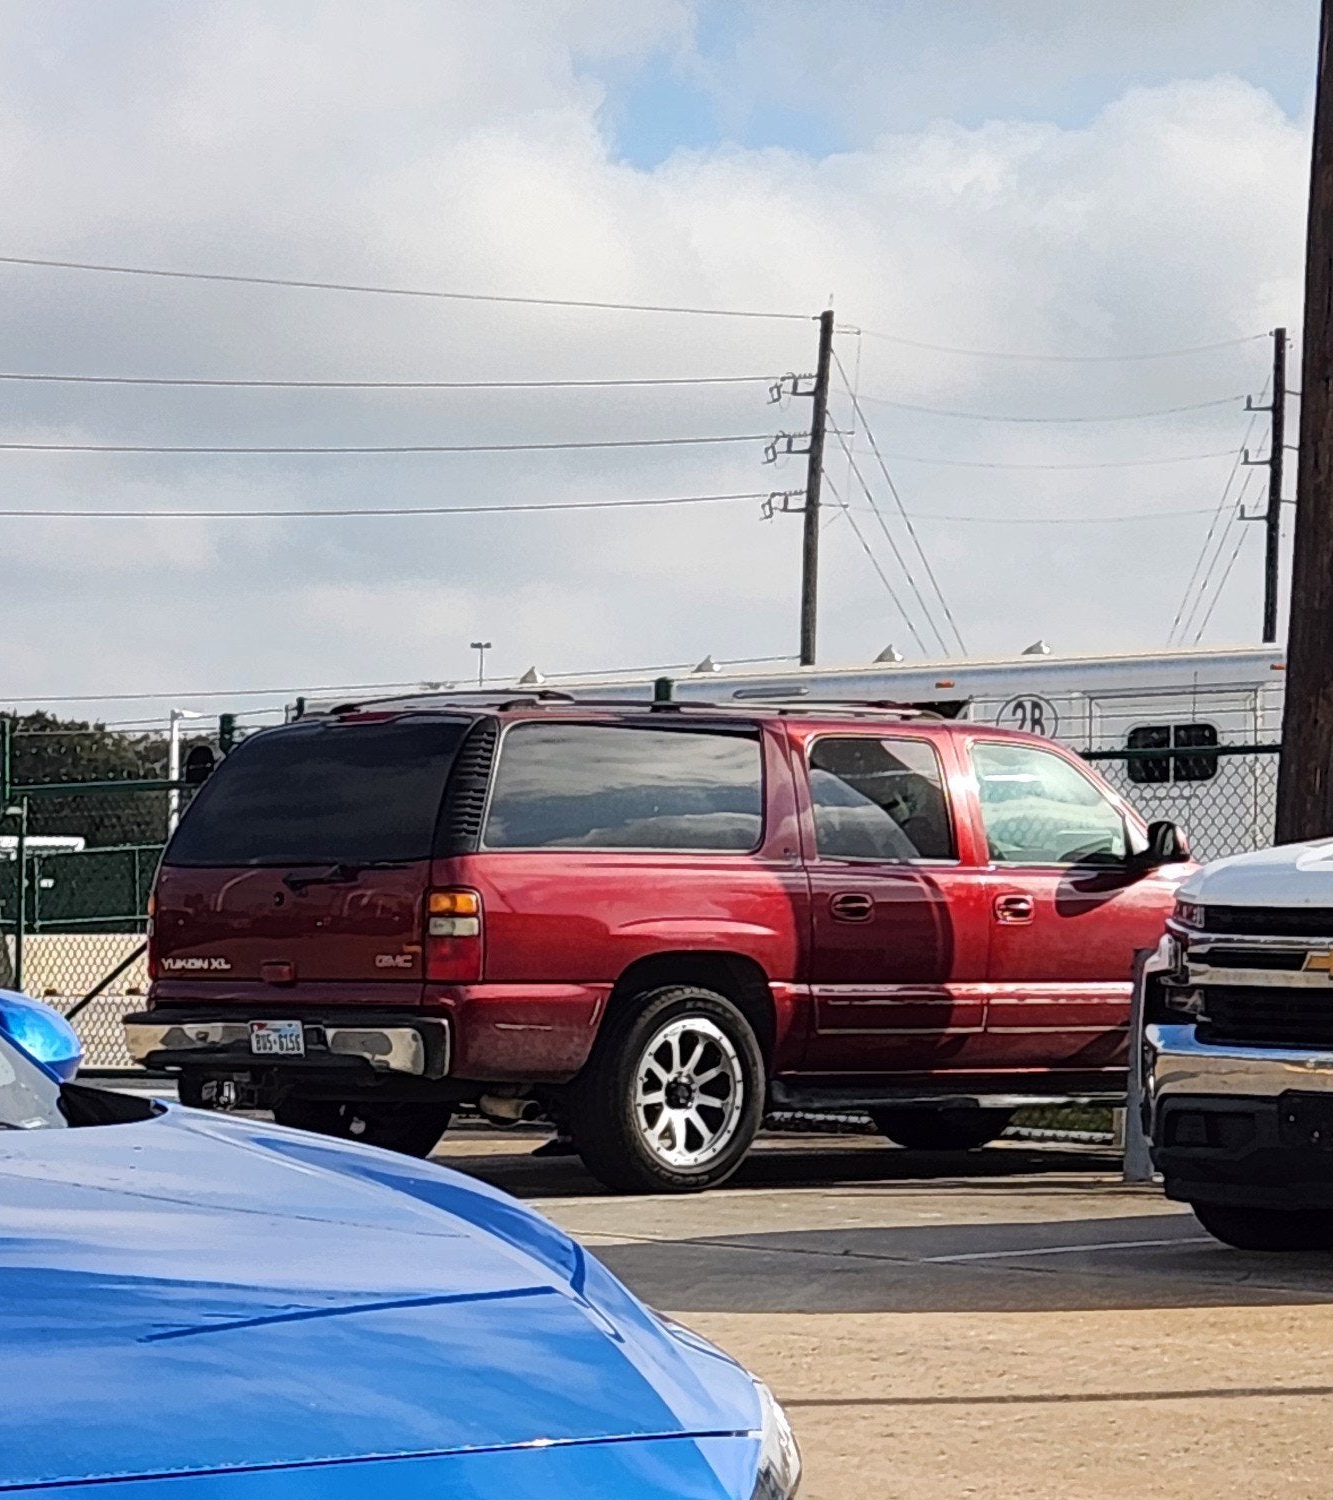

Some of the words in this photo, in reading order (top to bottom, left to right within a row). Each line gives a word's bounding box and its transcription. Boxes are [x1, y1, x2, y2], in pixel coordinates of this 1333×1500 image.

[161, 957, 209, 970] YUKON
[210, 957, 232, 970] XL
[375, 954, 413, 968] GMC
